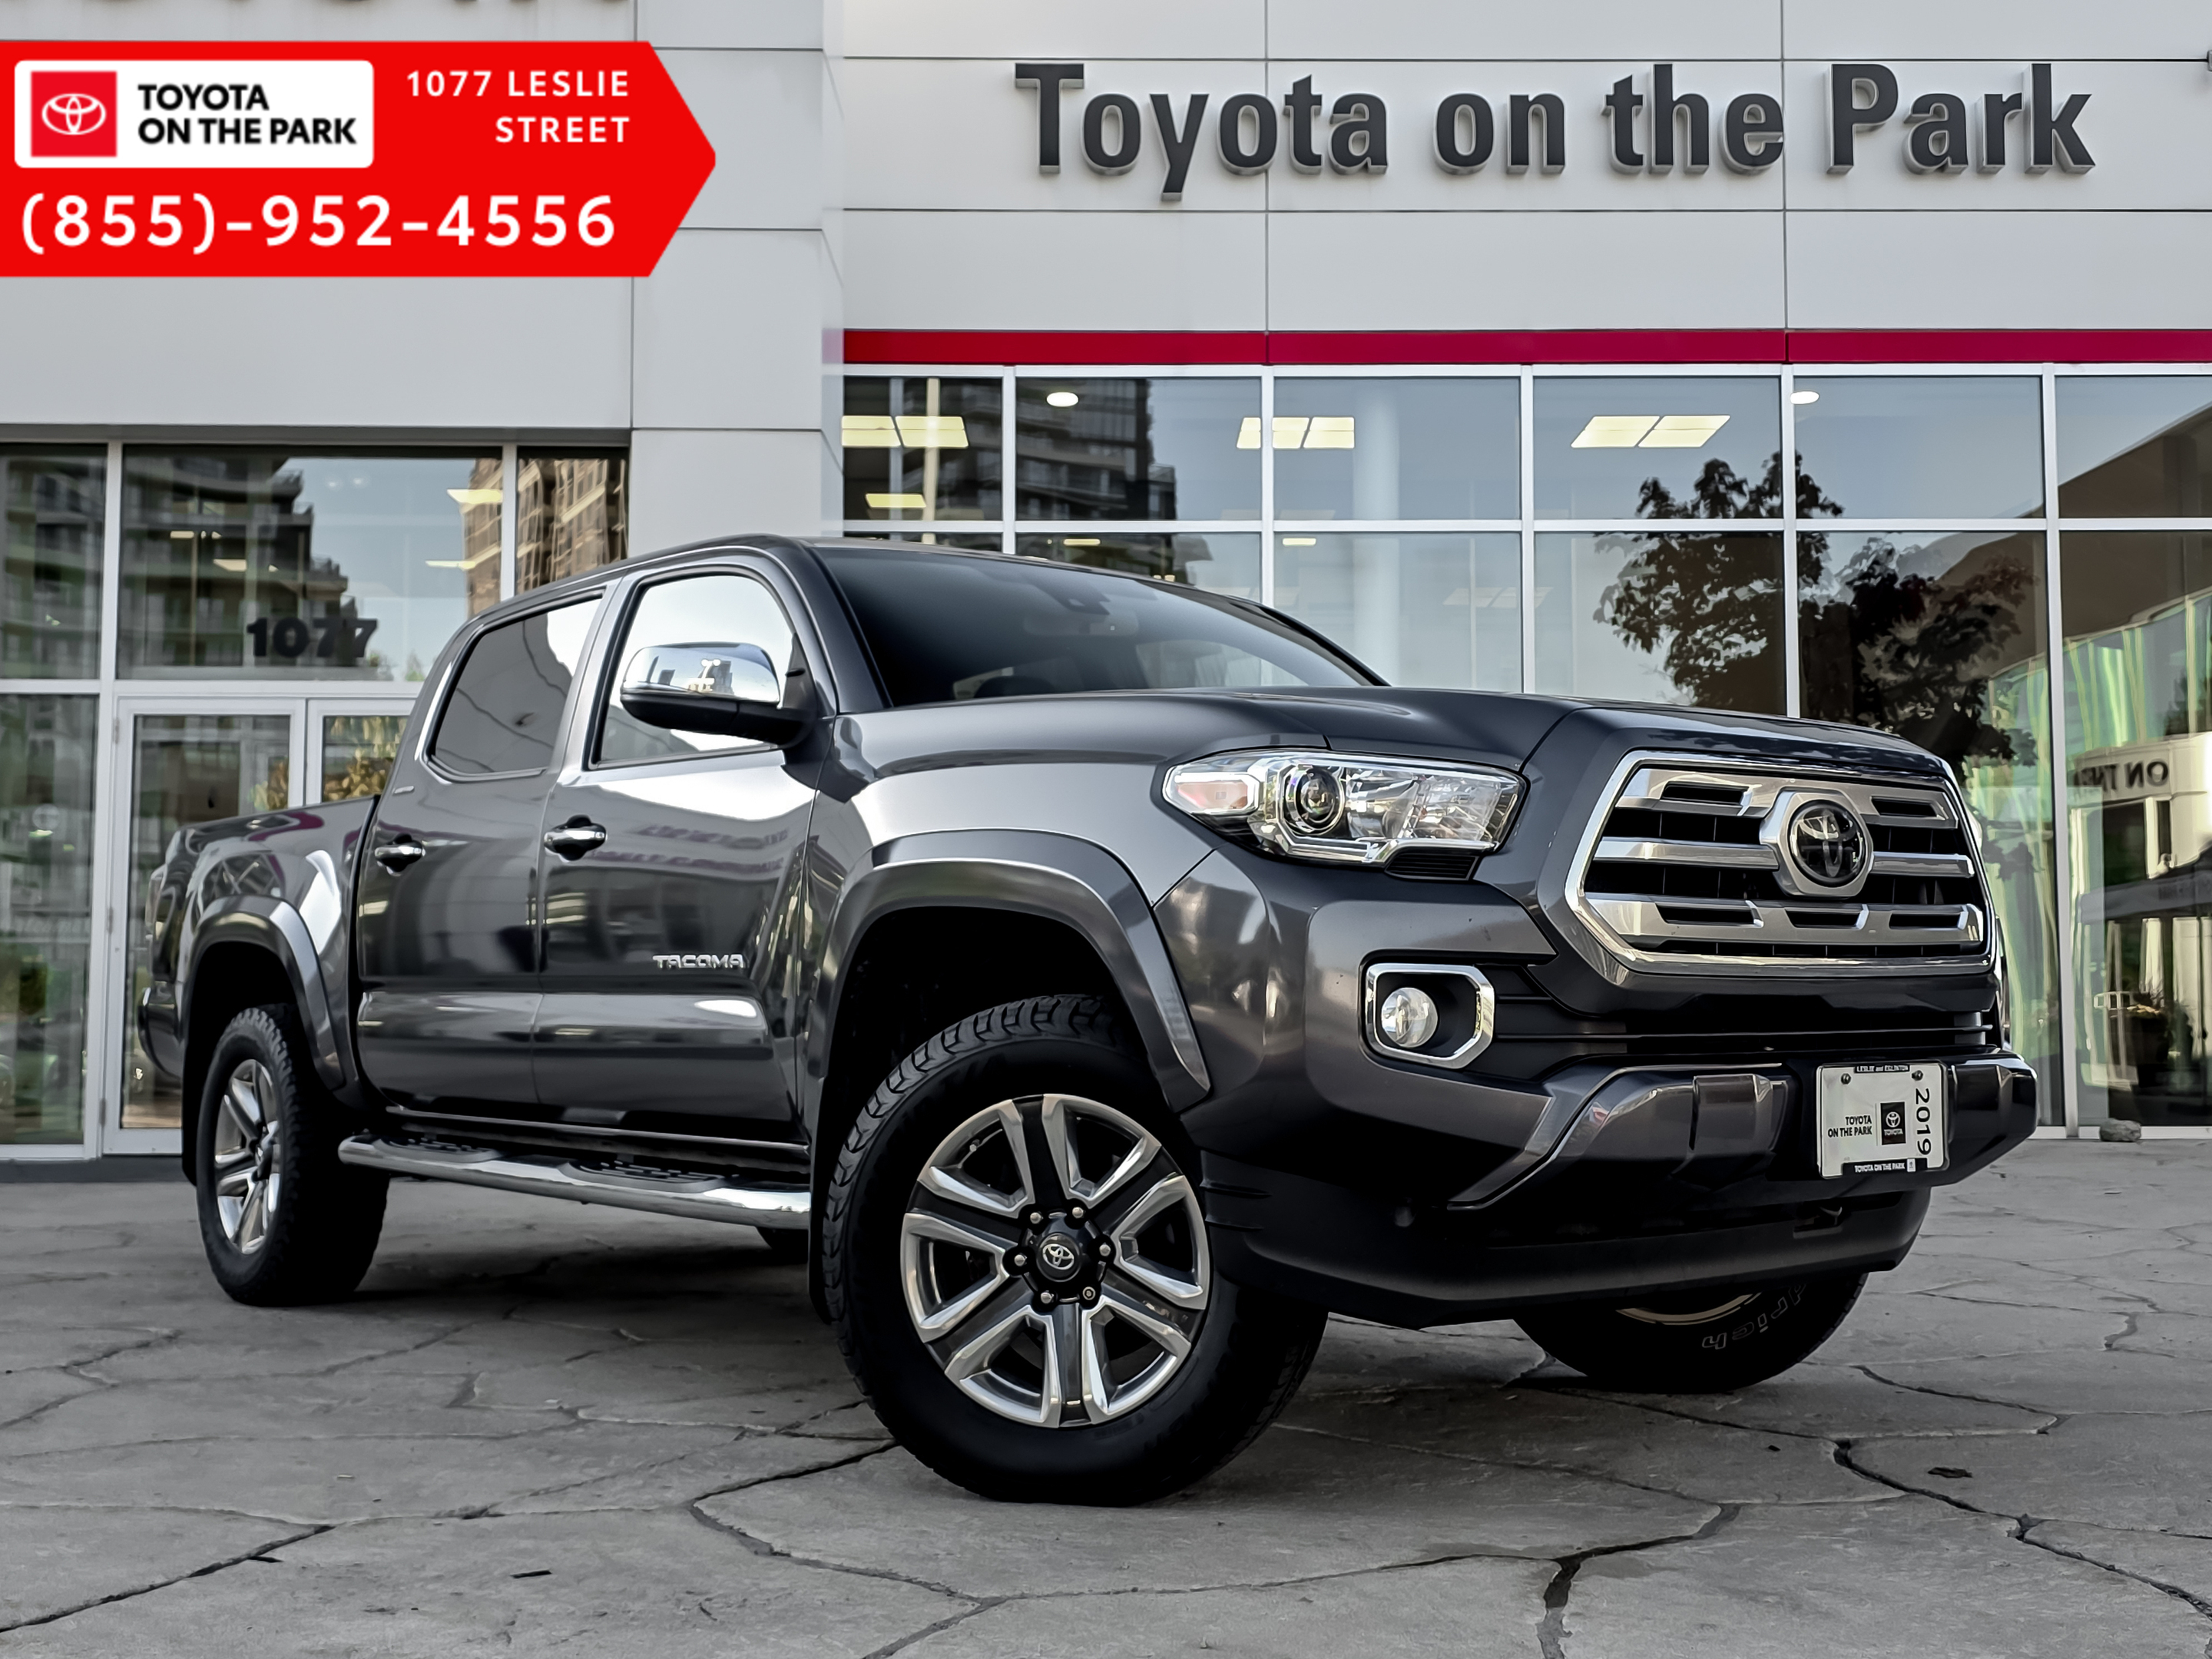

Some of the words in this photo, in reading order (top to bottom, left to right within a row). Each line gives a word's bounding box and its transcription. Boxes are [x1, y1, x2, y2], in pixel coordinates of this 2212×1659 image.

[1014, 63, 1389, 203] Toyota
[1432, 91, 1567, 176] on
[1604, 63, 1786, 176] the
[1824, 63, 2095, 176] Park
[247, 617, 378, 657] 1077
[653, 954, 745, 969] TACOMA
[1845, 1115, 1873, 1126] TOYOTA
[1916, 1088, 1932, 1156] 2019
[1827, 1128, 1839, 1138] ON
[1839, 1128, 1853, 1137] THE
[1854, 1126, 1873, 1136] PARK
[1854, 1164, 1873, 1173] TOYOTA
